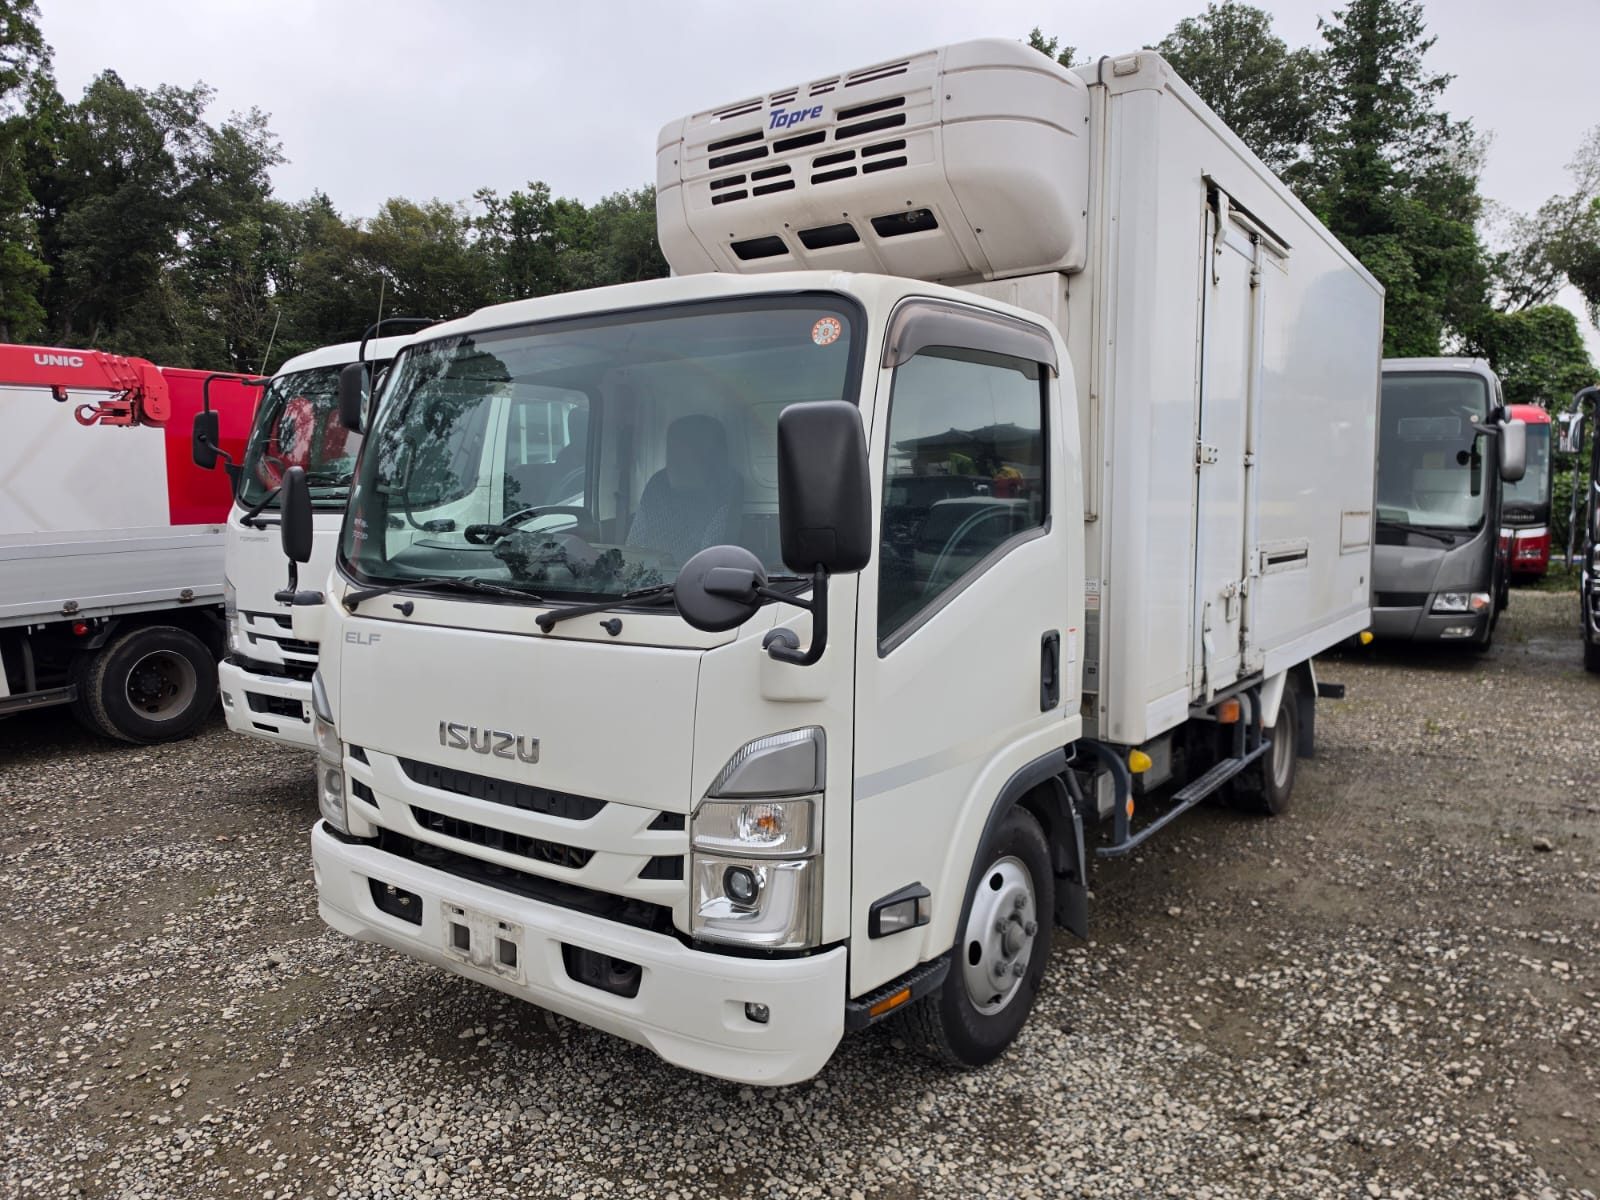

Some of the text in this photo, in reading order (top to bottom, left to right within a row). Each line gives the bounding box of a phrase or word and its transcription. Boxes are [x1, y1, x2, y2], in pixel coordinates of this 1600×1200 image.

[769, 105, 823, 129] Topre
[34, 353, 84, 368] UNIC
[345, 631, 382, 646] ELF
[439, 720, 540, 764] ISUZU
